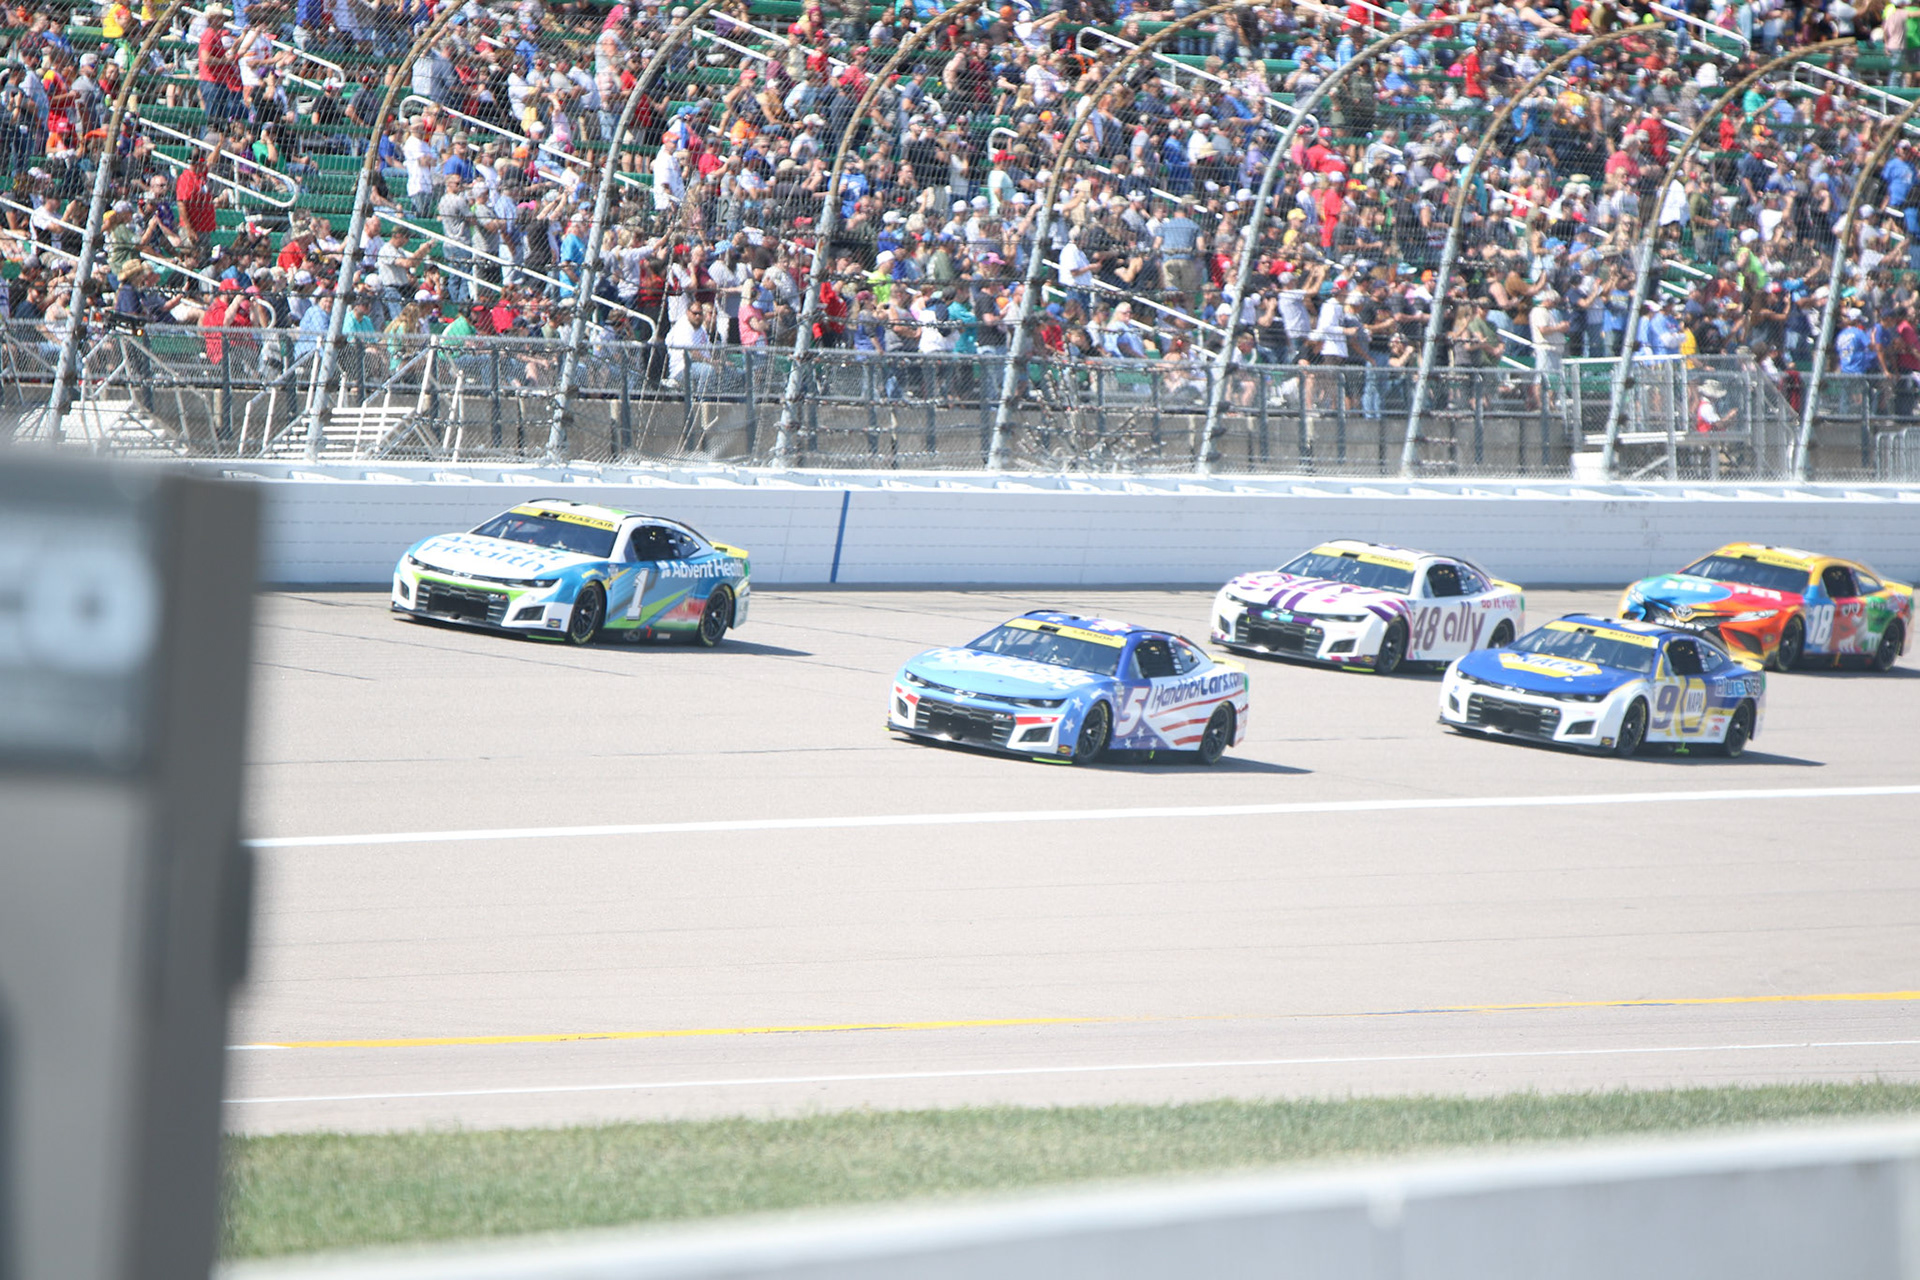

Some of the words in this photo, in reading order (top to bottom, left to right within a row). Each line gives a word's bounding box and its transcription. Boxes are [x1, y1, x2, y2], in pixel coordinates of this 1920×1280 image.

[717, 198, 730, 223] 12
[422, 541, 546, 574] Health
[671, 560, 712, 578] Advent
[712, 556, 744, 576] Health
[626, 567, 648, 621] 1
[1412, 606, 1440, 651] 48
[1442, 600, 1485, 653] ally
[1806, 604, 1835, 645] 18
[1115, 686, 1150, 737] 5
[1652, 684, 1680, 729] 9
[1687, 690, 1704, 714] NAPA
